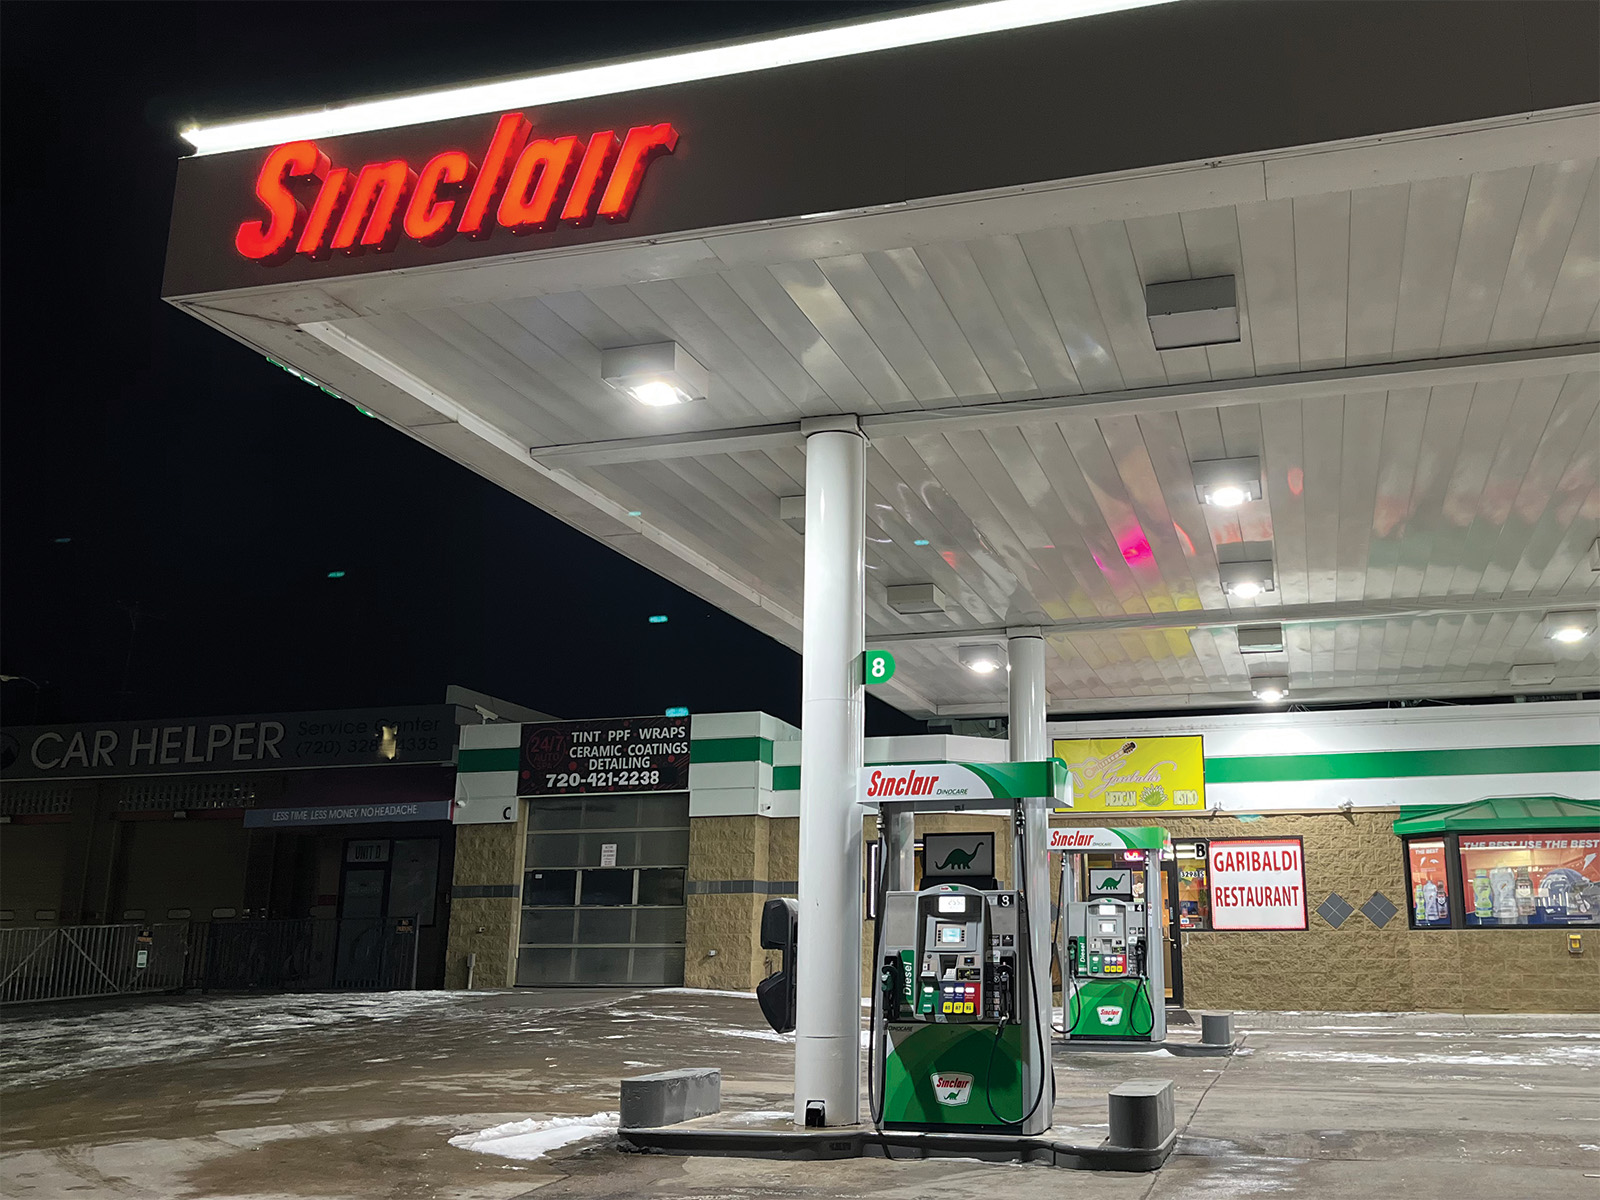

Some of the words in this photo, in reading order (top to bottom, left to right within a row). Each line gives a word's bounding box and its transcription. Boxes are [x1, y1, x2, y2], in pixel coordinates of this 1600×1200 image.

[236, 112, 678, 260] Sinclair
[871, 657, 885, 678] 8
[298, 719, 368, 737] Service
[571, 731, 602, 743] TINT
[608, 730, 631, 741] PPF
[639, 726, 686, 740] WRAPS
[31, 731, 119, 770] CAR
[128, 721, 286, 767] HELPER
[296, 740, 341, 758] (720)
[348, 737, 439, 753] 3284335
[531, 736, 565, 753] 24/7
[569, 745, 622, 758] CERAMIC
[588, 757, 651, 770] DETAILING
[546, 770, 660, 788] 720-421-2238
[867, 769, 940, 797] Sinclair
[936, 788, 968, 796] DINOCARE
[1105, 791, 1137, 806] MEXICAN
[272, 811, 289, 821] LESS
[311, 810, 328, 820] LESS
[503, 807, 511, 820] C
[1050, 830, 1095, 847] Sinclair
[1520, 841, 1542, 849] USE
[1545, 840, 1568, 849] THE
[1570, 839, 1600, 848] BEST
[355, 845, 374, 859] UNIT
[1196, 843, 1206, 858] B
[1213, 850, 1298, 872] GARIBALDI
[1215, 886, 1299, 907] RESTAURANT
[1137, 904, 1143, 912] 4
[902, 961, 913, 996] Diesel
[1100, 1008, 1121, 1017] Sinclair
[936, 1077, 970, 1089] Sinclair
